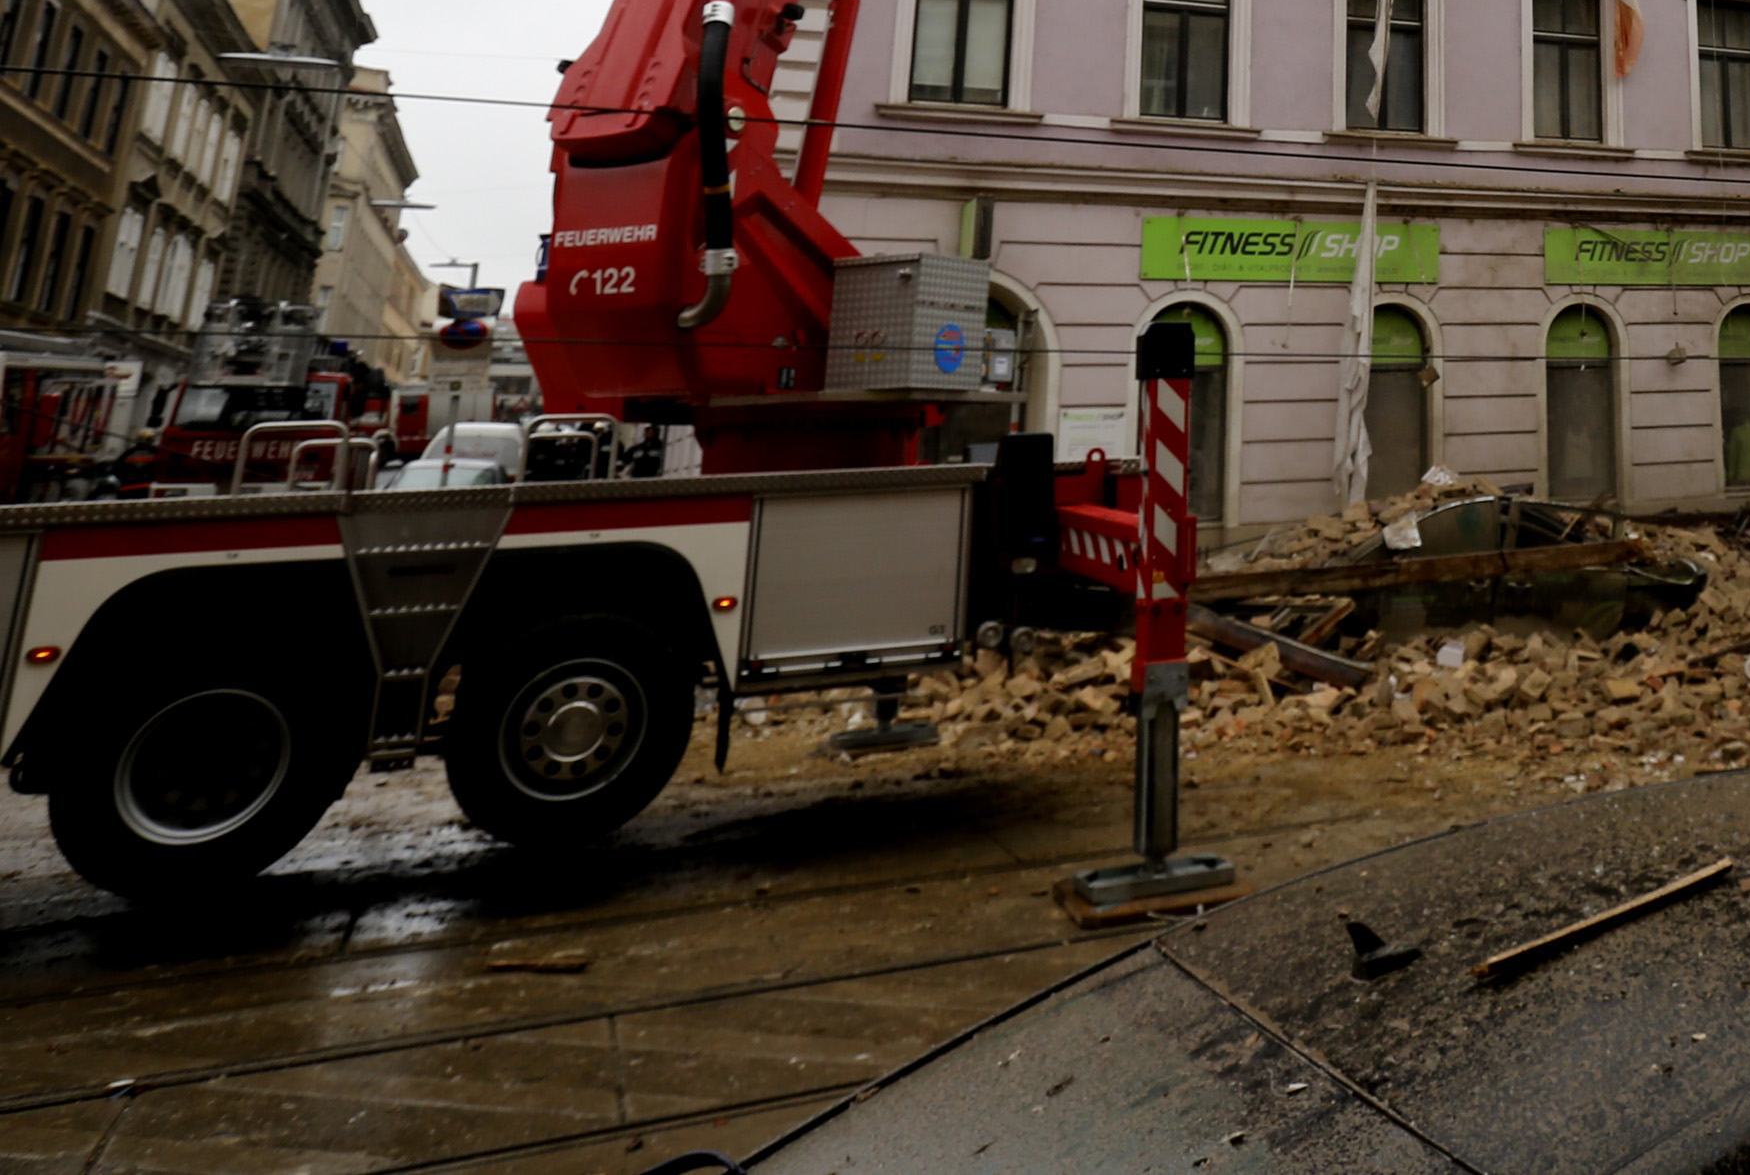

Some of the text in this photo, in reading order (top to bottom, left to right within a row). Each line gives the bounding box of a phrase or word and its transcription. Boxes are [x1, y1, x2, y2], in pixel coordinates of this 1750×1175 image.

[553, 224, 658, 248] FEUERWEHR
[1179, 231, 1297, 256] FITNESS
[1574, 240, 1750, 264] FITNESS SHOP
[591, 266, 635, 296] 122
[191, 440, 300, 461] FEUEWEH
